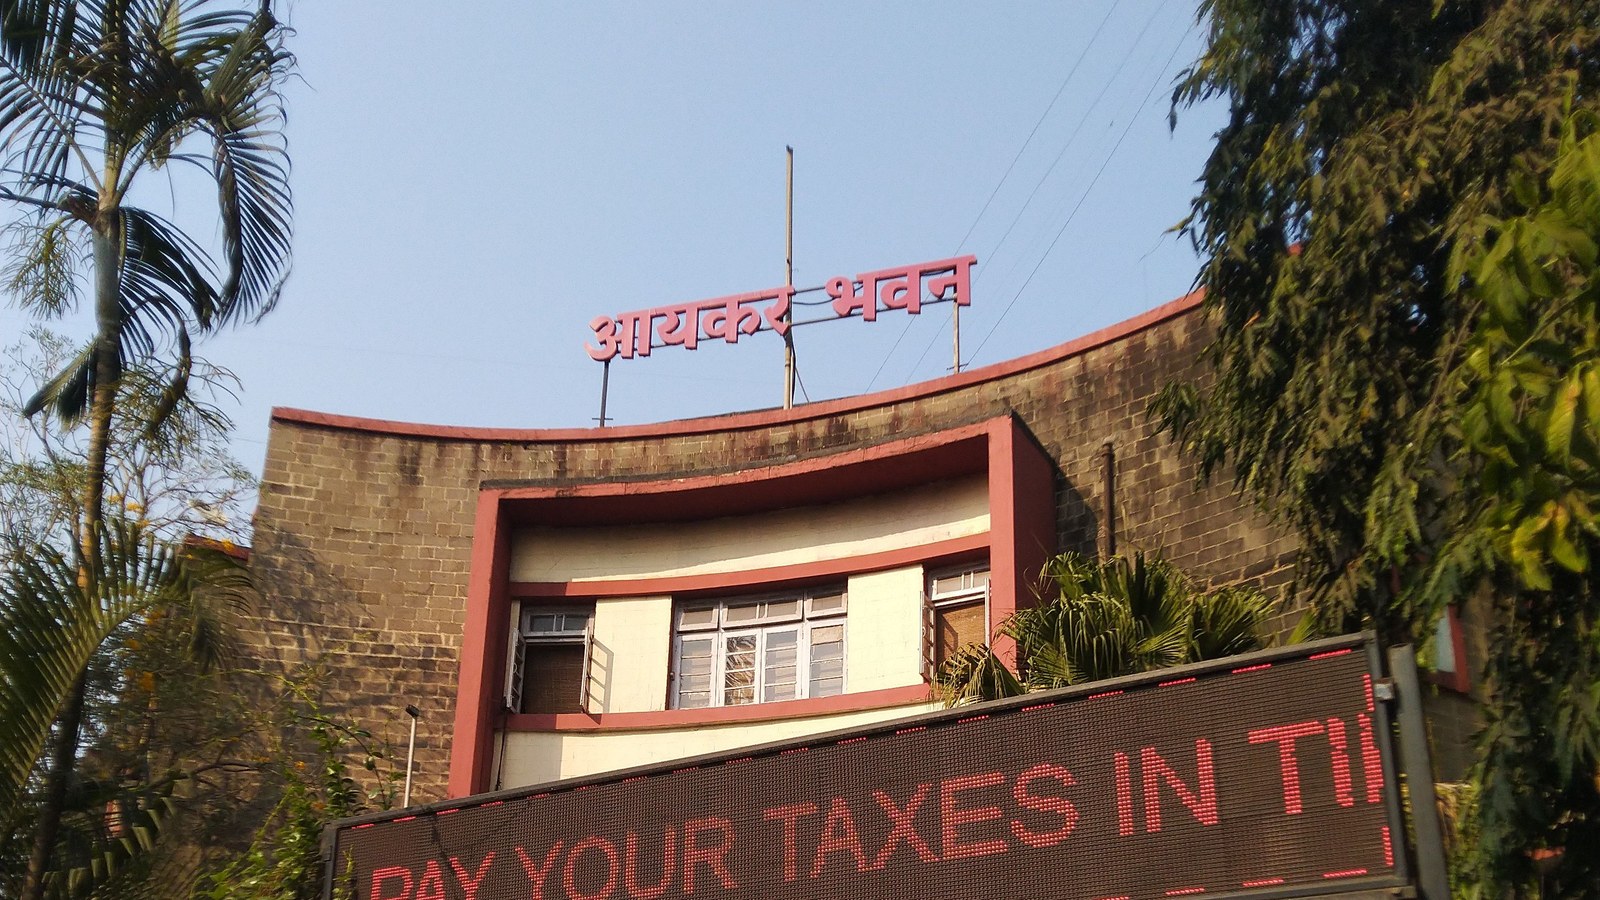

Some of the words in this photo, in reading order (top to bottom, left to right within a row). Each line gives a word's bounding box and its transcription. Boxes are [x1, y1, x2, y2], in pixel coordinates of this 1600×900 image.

[584, 286, 796, 361] आयकर
[825, 254, 977, 321] भवन
[514, 817, 739, 900] YOUR
[763, 763, 1080, 882] TAXES
[1114, 738, 1219, 836] IN
